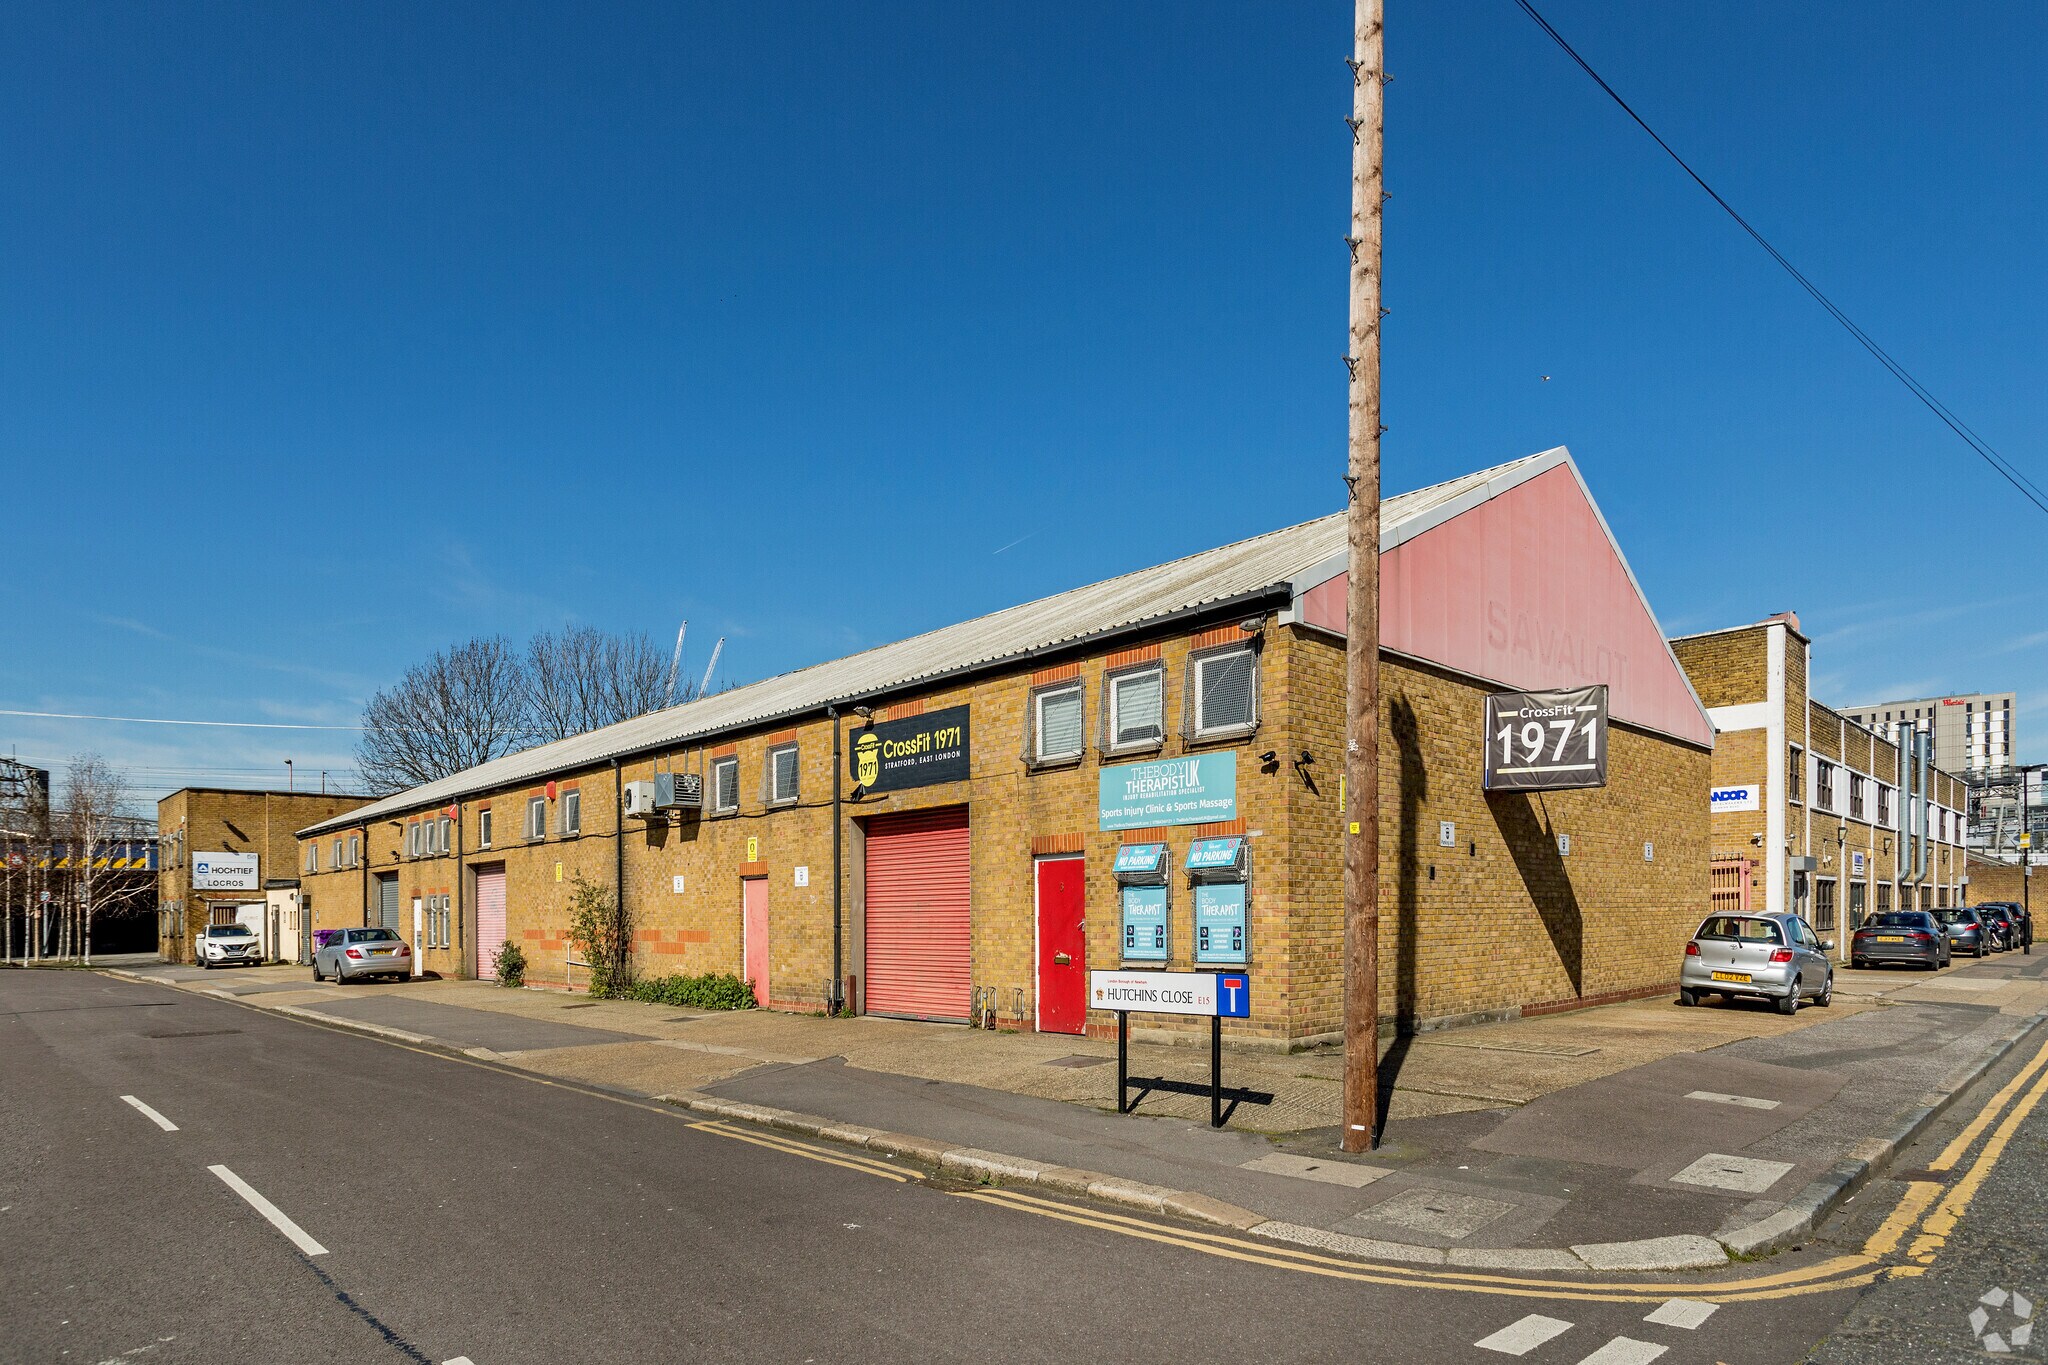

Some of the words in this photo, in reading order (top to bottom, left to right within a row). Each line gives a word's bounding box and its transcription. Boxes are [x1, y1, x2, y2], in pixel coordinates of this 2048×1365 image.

[1519, 704, 1574, 718] CrossFit
[883, 732, 931, 759] CrossFit
[934, 726, 960, 750] 1971
[1497, 717, 1597, 765] 1971
[919, 754, 933, 764] EAST
[935, 750, 960, 761] LONDON
[860, 761, 877, 777] 1971
[1126, 775, 1185, 794] THERAPIST
[1122, 793, 1139, 801] INJURY
[1140, 790, 1177, 799] REHABILITATION
[1178, 786, 1205, 795] SPECIALIST
[1101, 808, 1123, 819] Sports
[1124, 806, 1144, 818] Injury
[1145, 804, 1165, 814] Clinic
[1166, 803, 1173, 812] &
[1174, 801, 1198, 812] Sports
[1199, 798, 1233, 809] Massage
[1118, 856, 1128, 866] NO
[1128, 854, 1156, 865] PARKING
[1191, 852, 1202, 863] NO
[1202, 850, 1233, 861] PARKING
[211, 867, 254, 875] HOCHTIEF
[1128, 903, 1162, 915] THERAPIST
[1201, 903, 1240, 916] THERAPIST
[1107, 988, 1158, 1002] HUTCHINS
[1161, 990, 1193, 1004] CLOSE
[1198, 996, 1210, 1005] E15
